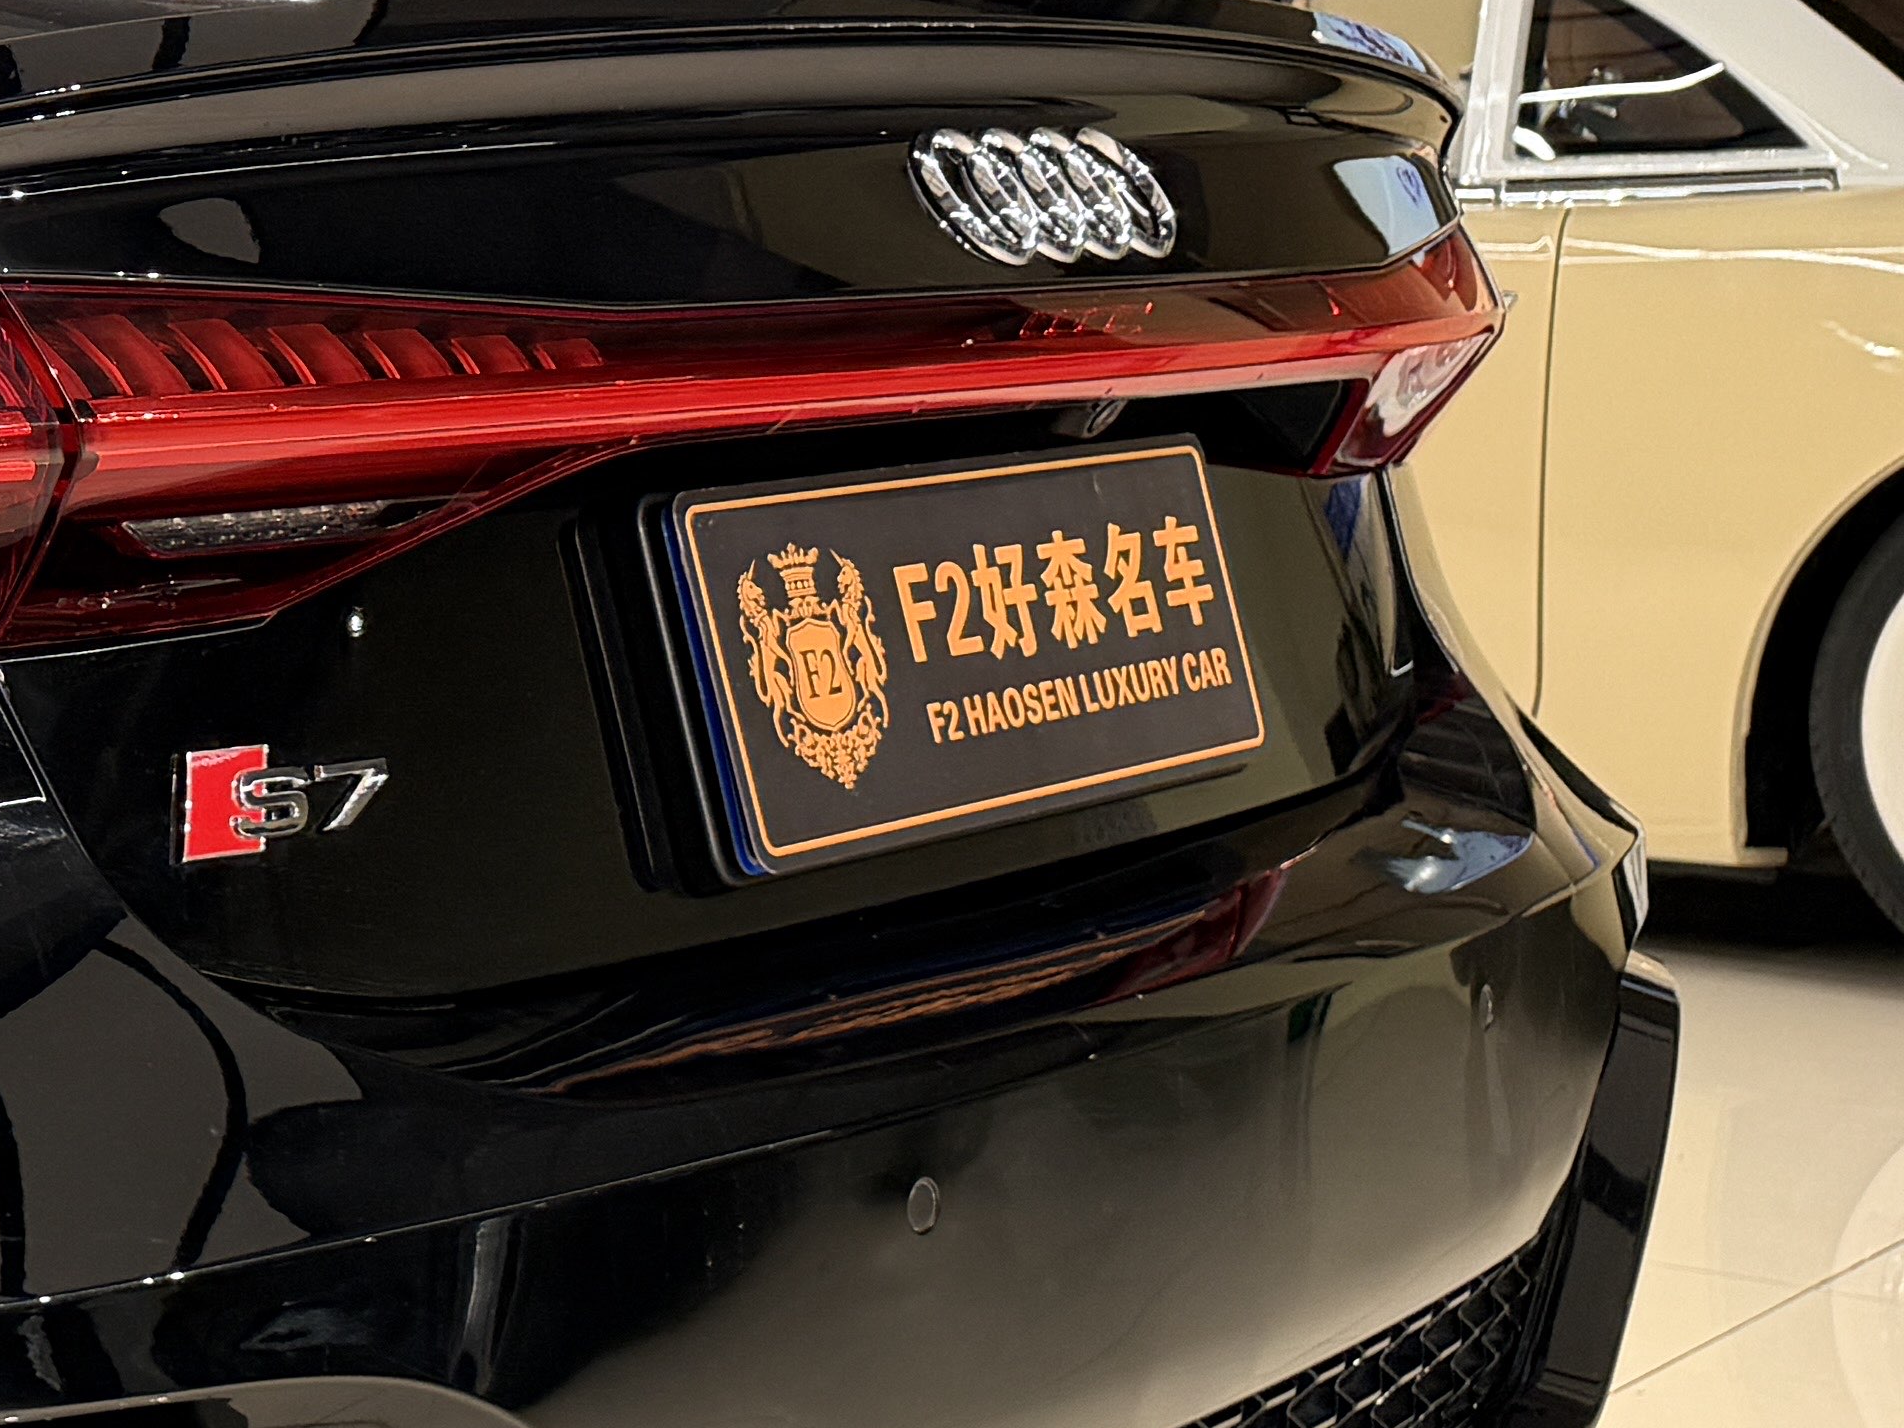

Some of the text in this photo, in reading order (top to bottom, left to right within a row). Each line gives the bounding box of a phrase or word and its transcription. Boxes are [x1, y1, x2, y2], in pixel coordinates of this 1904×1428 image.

[893, 515, 1214, 662] F2好森名车
[799, 647, 846, 702] F2
[926, 646, 1232, 744] F2 HAOSEN LUXURY CAR
